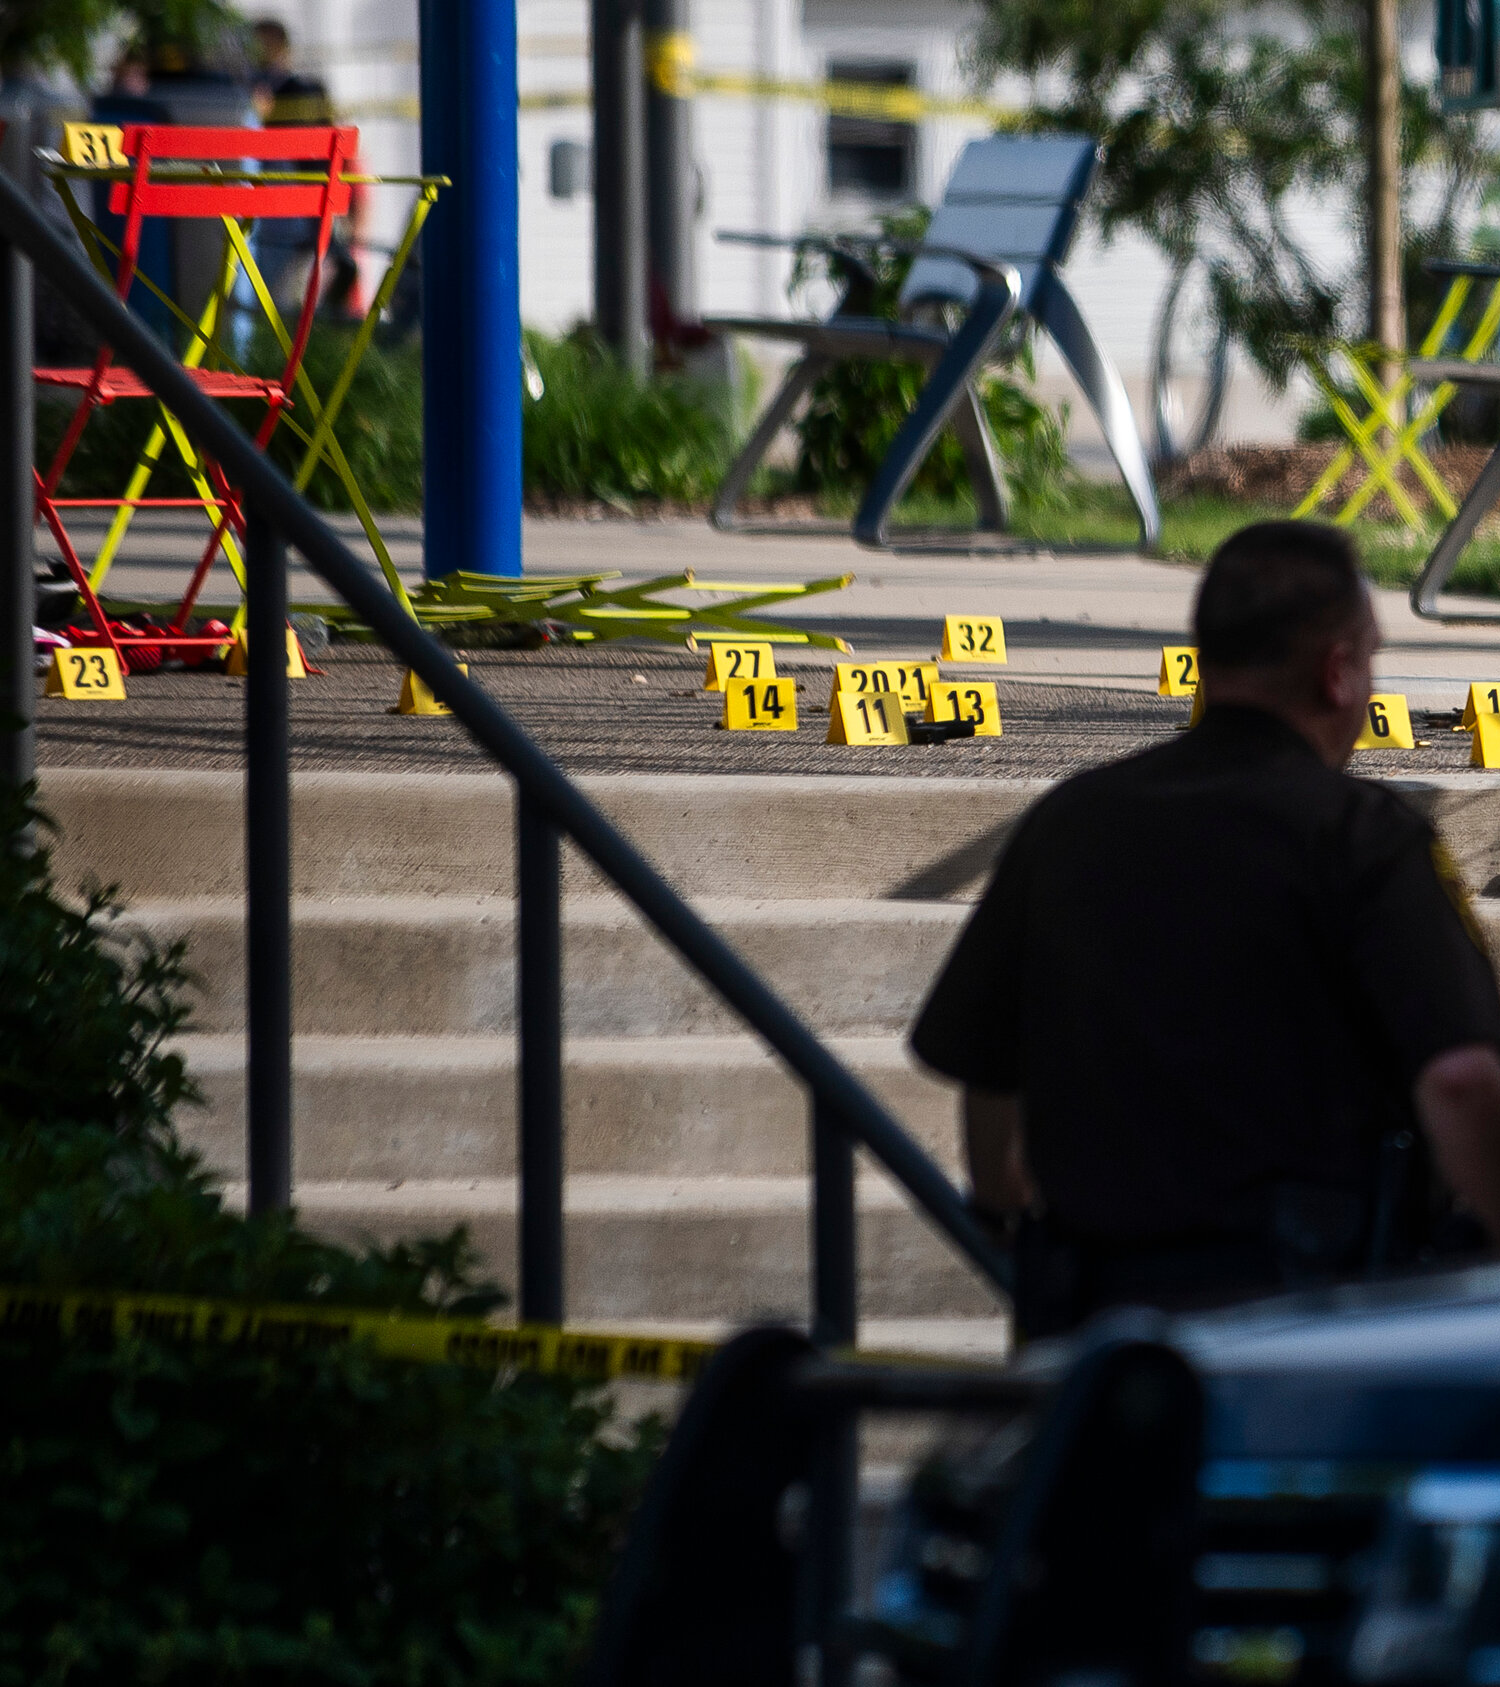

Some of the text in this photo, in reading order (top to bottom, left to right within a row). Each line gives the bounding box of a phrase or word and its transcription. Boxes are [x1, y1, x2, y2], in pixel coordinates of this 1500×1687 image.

[80, 131, 114, 165] 31
[958, 623, 996, 653] 32
[70, 655, 109, 688] 23
[726, 649, 760, 677] 27
[851, 669, 890, 692] 20
[743, 685, 784, 719] 14
[856, 698, 889, 733] 11
[947, 689, 984, 725] 13
[1367, 701, 1390, 738] 6
